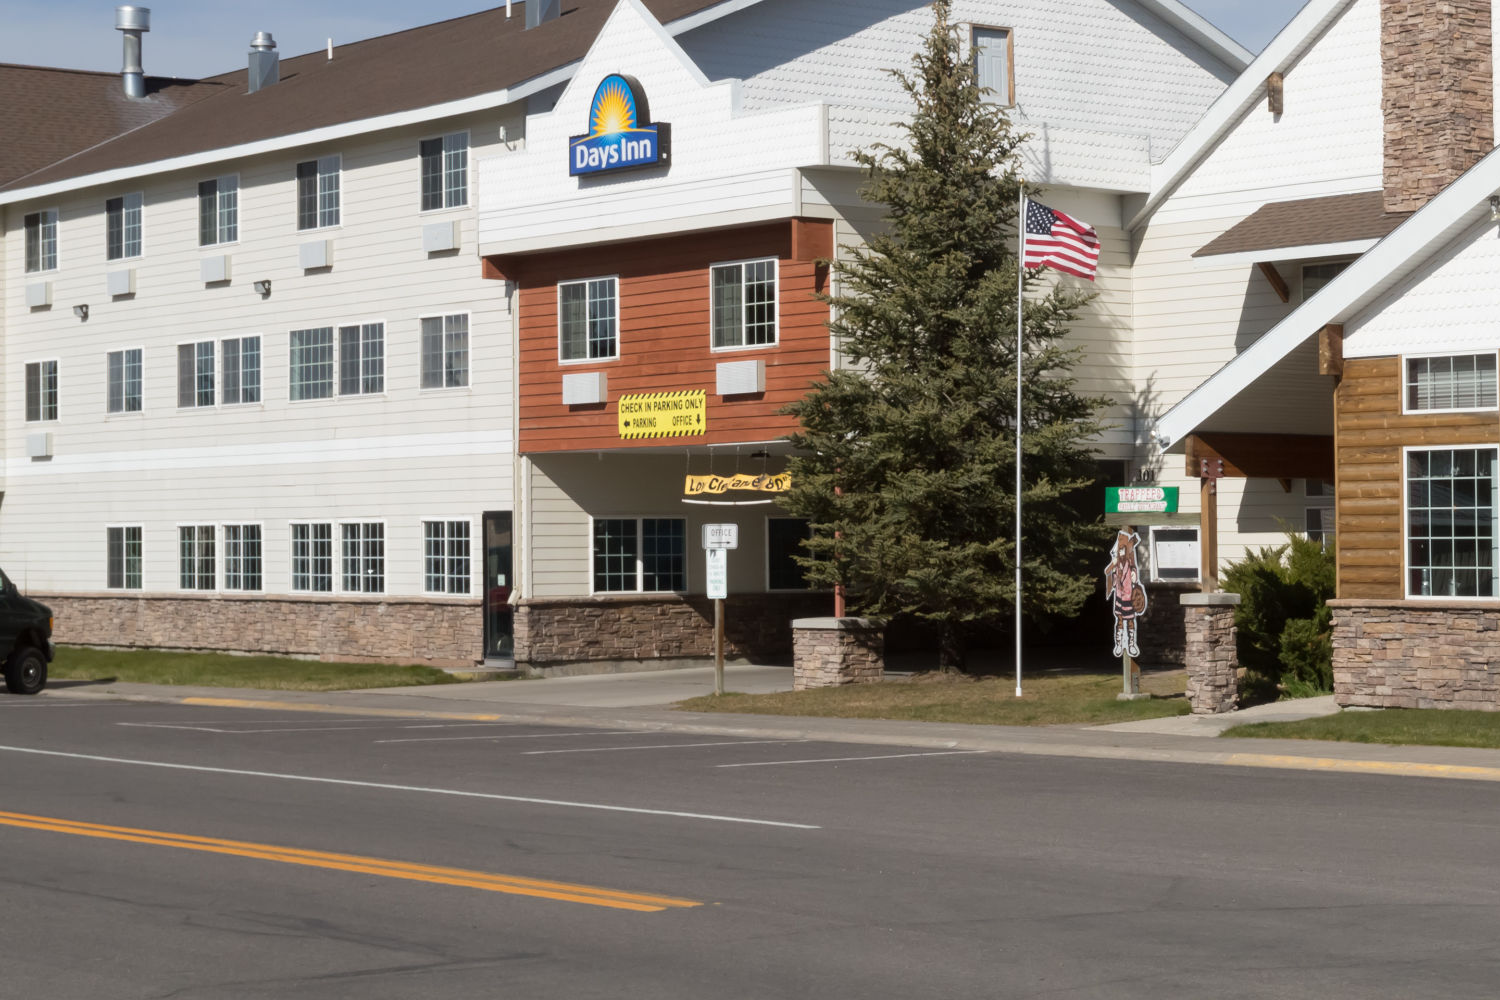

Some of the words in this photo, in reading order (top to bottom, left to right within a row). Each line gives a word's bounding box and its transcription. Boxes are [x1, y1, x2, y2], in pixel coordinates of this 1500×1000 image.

[575, 143, 619, 169] Days
[620, 138, 652, 162] Inn
[620, 402, 643, 414] CHECK
[645, 401, 652, 413] IN
[653, 399, 683, 412] PARKING
[684, 398, 704, 410] ONLY
[632, 416, 657, 429] PARKING
[672, 414, 693, 427] OFFICE
[710, 528, 732, 537] OFFICE
